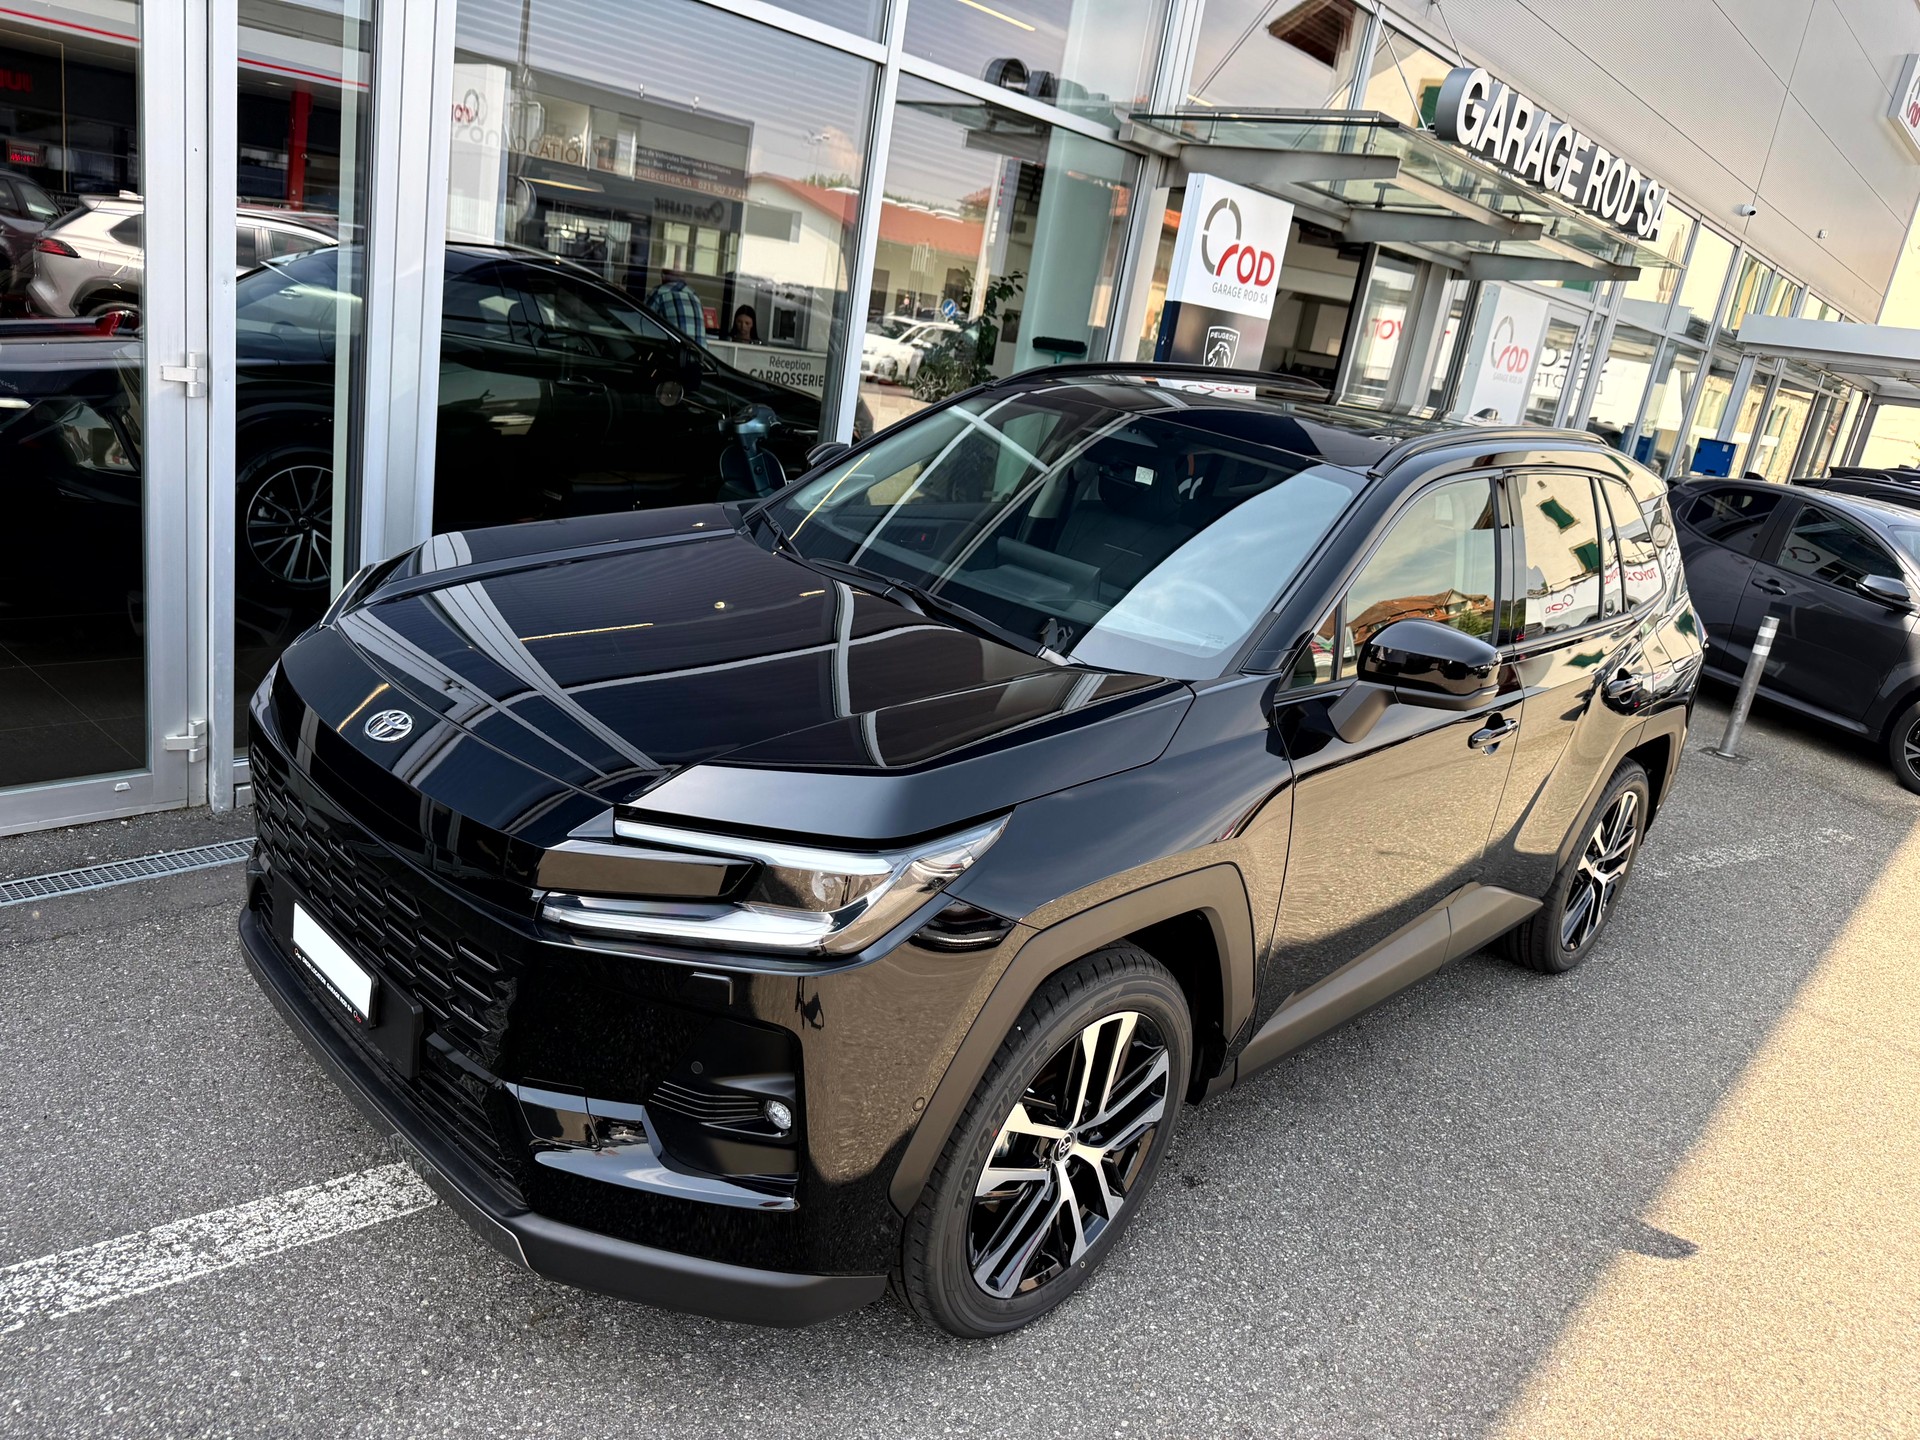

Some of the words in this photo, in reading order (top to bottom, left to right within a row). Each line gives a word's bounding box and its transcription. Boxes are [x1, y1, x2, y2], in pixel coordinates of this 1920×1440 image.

[1456, 67, 1592, 200] GARAGE
[1582, 145, 1641, 226] ROD
[1636, 179, 1669, 240] SA
[1212, 281, 1242, 300] GARAGE
[1243, 288, 1258, 303] ROD
[1259, 292, 1268, 305] SA
[1210, 331, 1237, 343] PEUGEOT
[769, 355, 811, 372] Réception
[749, 368, 824, 388] CARROSSERIE
[954, 1127, 992, 1209] TOYO
[990, 1039, 1049, 1127] TIRES
